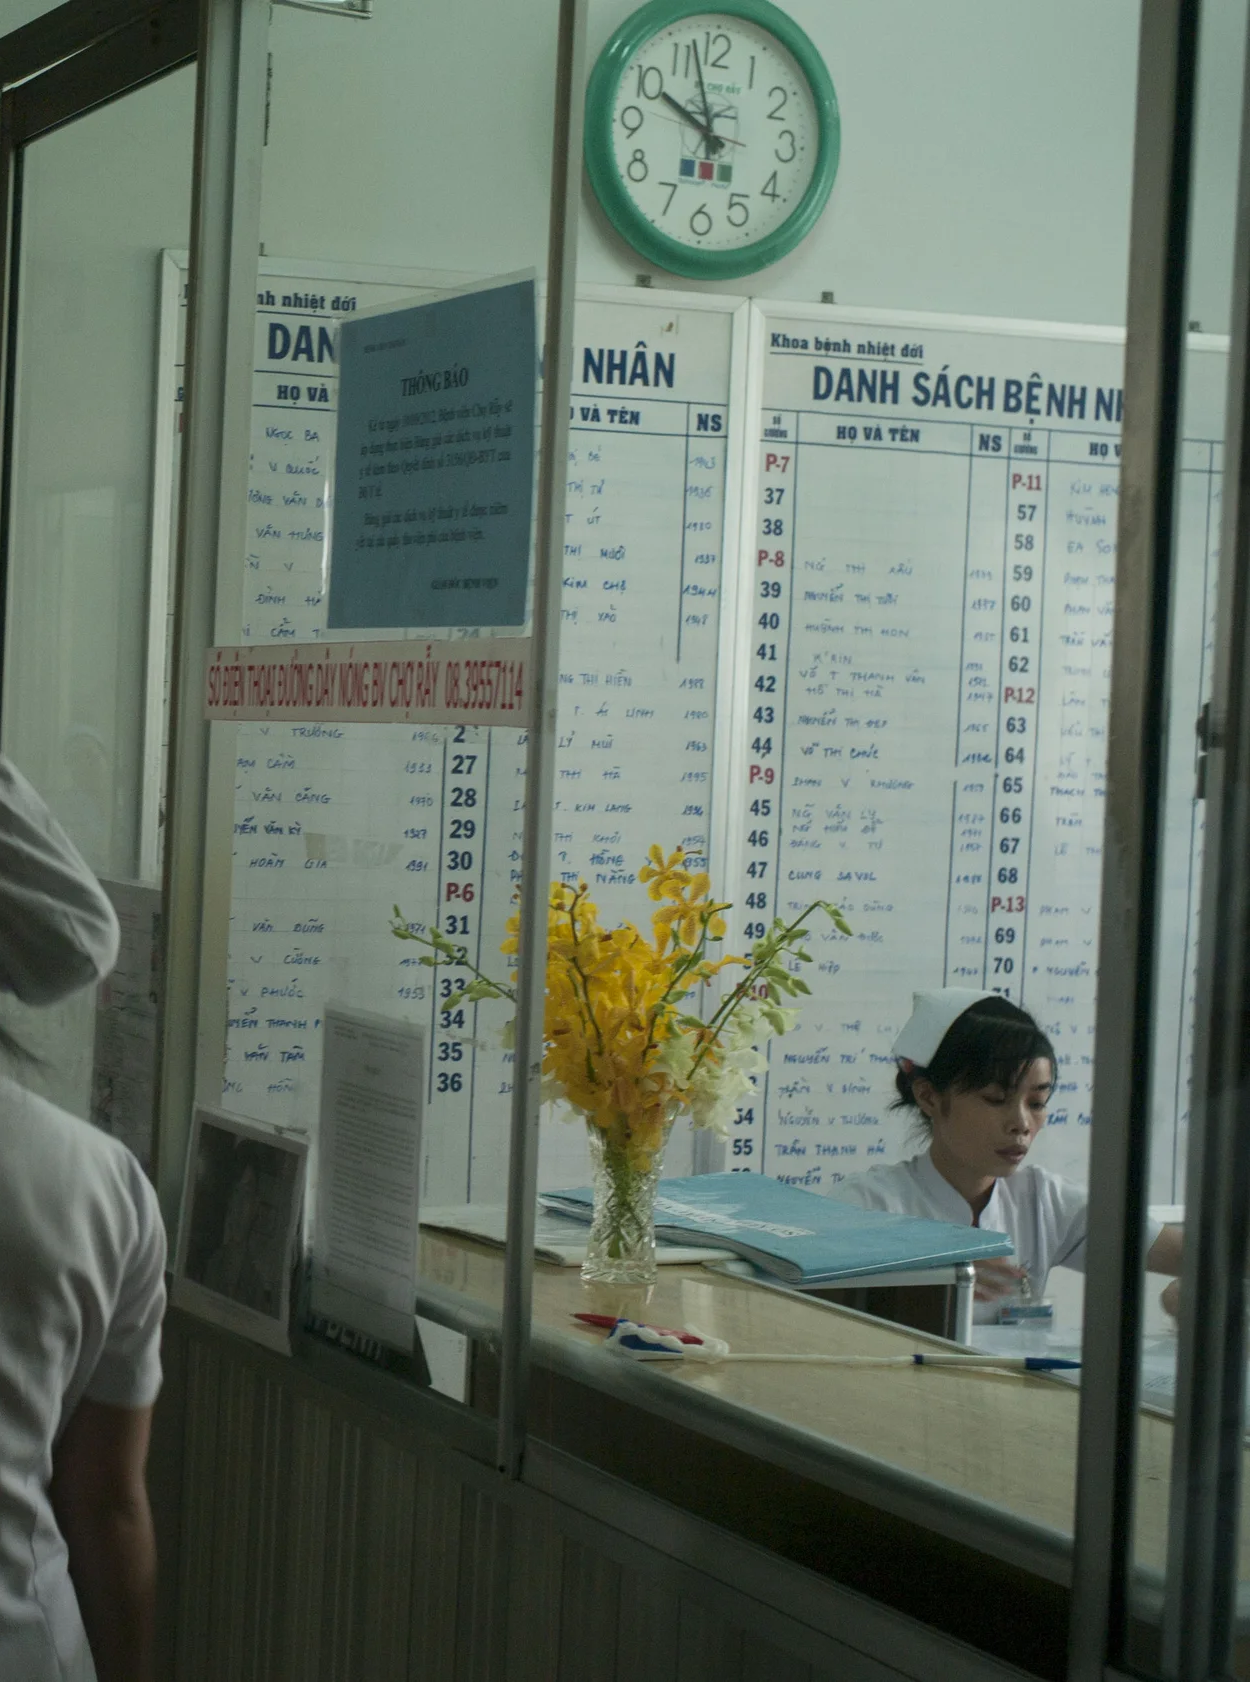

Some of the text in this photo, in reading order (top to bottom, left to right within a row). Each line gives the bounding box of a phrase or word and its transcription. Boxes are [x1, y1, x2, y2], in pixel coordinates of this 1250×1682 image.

[704, 31, 732, 69] 12
[671, 42, 691, 79] 11
[636, 64, 664, 100] 10
[748, 55, 756, 90] 1
[766, 86, 788, 121] 2
[621, 105, 644, 140] 9
[774, 129, 797, 163] 3
[626, 148, 649, 183] 8
[760, 169, 782, 204] 4
[657, 181, 678, 217] 7
[726, 192, 751, 228] 5
[689, 203, 714, 237] 6
[281, 292, 326, 313] nhiệt
[331, 294, 357, 312] đới
[770, 333, 925, 362] Khoa bệnh nhiệt đới
[582, 339, 677, 389] NHÂN
[443, 361, 470, 390] BÁO
[277, 382, 329, 405] HỌ VÀ
[812, 366, 900, 405] DANH
[912, 364, 996, 410] SÁCH
[1003, 372, 1087, 424] BỆNH
[580, 402, 641, 426] VÀ TÊN
[695, 412, 723, 433] NS
[836, 423, 921, 444] HỌ VÀ TÊN
[978, 433, 1002, 451] NS
[1089, 442, 1109, 460] HỌ
[765, 453, 791, 473] P-7
[1011, 473, 1042, 492] P-11
[764, 487, 785, 505] 37
[1016, 504, 1037, 523] 57
[762, 518, 783, 536] 38
[1013, 533, 1034, 552] 58
[757, 549, 785, 568] P-8
[1012, 564, 1033, 582] 59
[760, 580, 782, 599] 39
[1010, 594, 1032, 612] 60
[758, 612, 780, 631] 40
[1009, 626, 1030, 644] 61
[756, 643, 777, 661] 41
[1007, 655, 1030, 673] 62
[754, 674, 777, 693] 42
[753, 705, 775, 724] 43
[1005, 716, 1027, 734] 63
[751, 736, 773, 754] 44
[451, 755, 477, 774] 27
[1003, 746, 1025, 764] 64
[749, 764, 775, 785] P-9
[1002, 776, 1024, 794] 65
[451, 787, 477, 807] 28
[749, 799, 772, 817] 45
[999, 806, 1022, 824] 66
[450, 819, 476, 839] 29
[747, 829, 769, 848] 46
[999, 837, 1021, 855] 67
[447, 851, 472, 870] 30
[746, 861, 768, 879] 47
[997, 866, 1019, 884] 68
[446, 882, 475, 902] P-6
[745, 892, 767, 910] 48
[990, 895, 1025, 913] P-13
[445, 915, 469, 935] 31
[744, 922, 765, 939] 49
[994, 926, 1016, 944] 69
[993, 956, 1014, 974] 70
[440, 1009, 465, 1029] 34
[437, 1041, 463, 1062] 35
[436, 1072, 462, 1093] 36
[732, 1138, 753, 1156] 55
